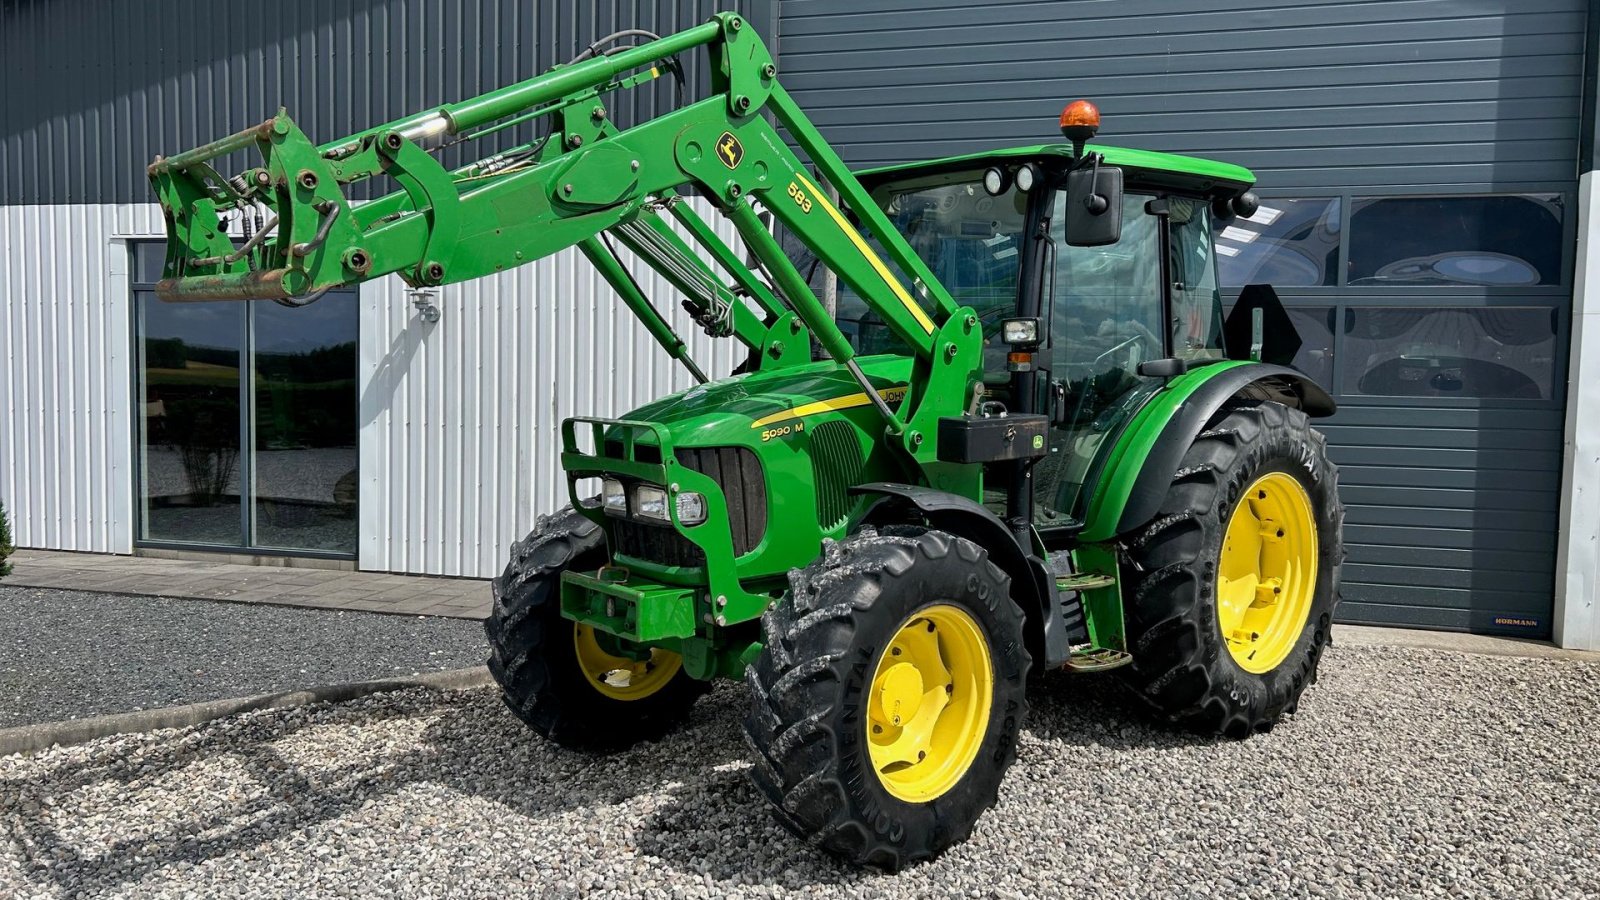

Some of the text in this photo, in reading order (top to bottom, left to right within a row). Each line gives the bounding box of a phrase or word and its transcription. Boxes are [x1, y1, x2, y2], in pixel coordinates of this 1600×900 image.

[787, 182, 812, 213] 583
[762, 422, 805, 442] 5090 M
